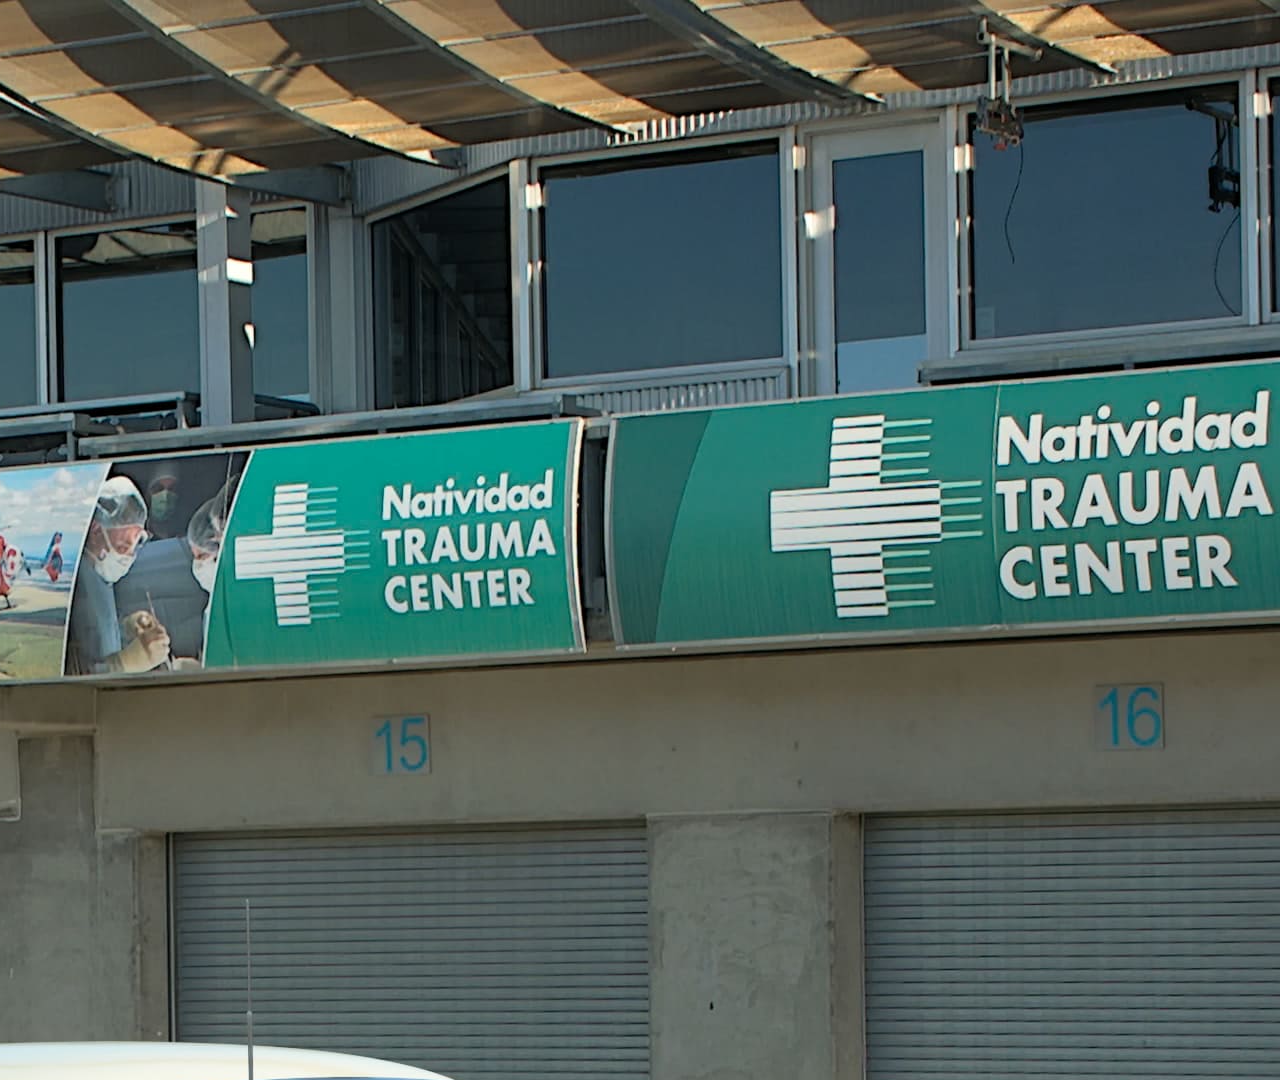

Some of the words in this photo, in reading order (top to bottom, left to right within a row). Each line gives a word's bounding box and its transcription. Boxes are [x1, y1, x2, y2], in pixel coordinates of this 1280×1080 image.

[997, 390, 1270, 465] Natividad
[382, 469, 554, 520] Natividad
[995, 462, 1273, 532] TRAUMA
[381, 518, 556, 566] TRAUMA
[1000, 535, 1238, 599] CENTER
[384, 568, 534, 613] CENTER
[375, 716, 427, 773] 15
[1098, 687, 1161, 747] 16
